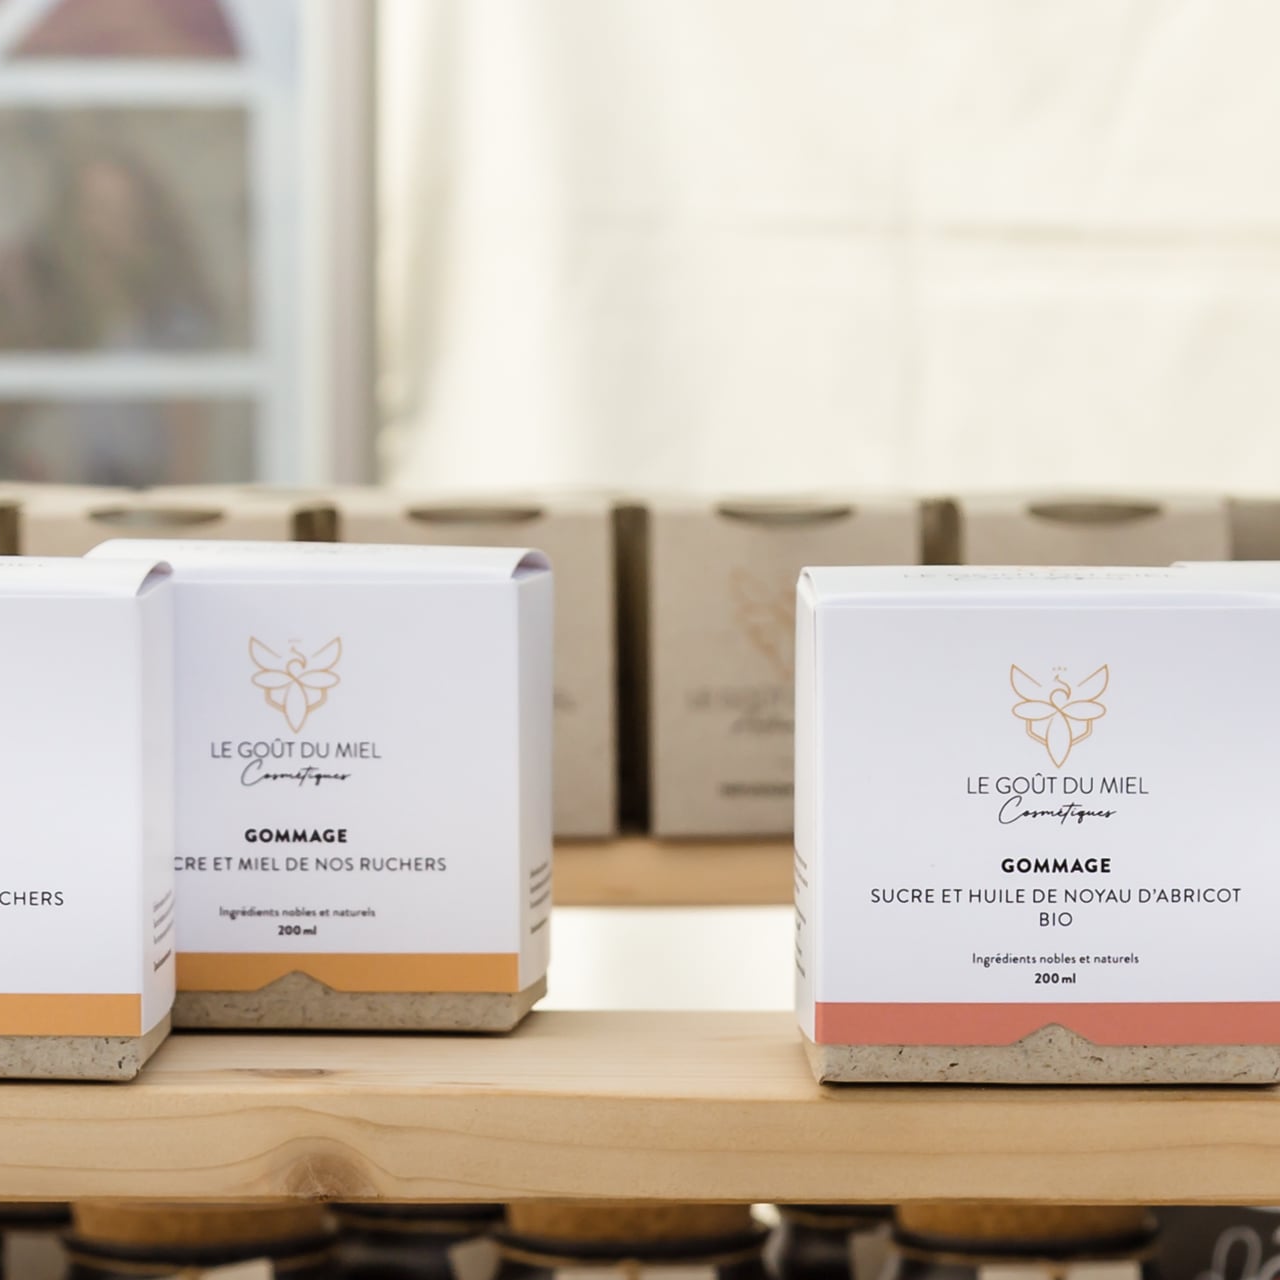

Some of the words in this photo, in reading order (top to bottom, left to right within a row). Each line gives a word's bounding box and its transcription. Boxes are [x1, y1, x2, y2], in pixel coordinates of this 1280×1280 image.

[966, 776, 990, 795] LE
[994, 772, 1058, 797] GOÛT
[1062, 776, 1094, 795] DU
[1099, 776, 1149, 795] MIEL
[997, 794, 1117, 825] Cosmétiques
[244, 828, 347, 843] GOMMAGE
[1000, 857, 1111, 874] GOMMAGE
[870, 887, 935, 904] SUCRE
[941, 888, 963, 904] ET
[968, 888, 1025, 904] HUILE
[1032, 888, 1057, 904] DE
[1064, 888, 1131, 904] NOYAU
[1138, 887, 1241, 904] D'ABRICOT
[1039, 911, 1073, 927] BIO
[971, 952, 1037, 969] Ingrédients
[1038, 952, 1077, 964] nobles
[1078, 954, 1091, 964] et
[1093, 952, 1140, 964] naturels
[1034, 972, 1060, 984] 200
[1060, 972, 1076, 984] ml
